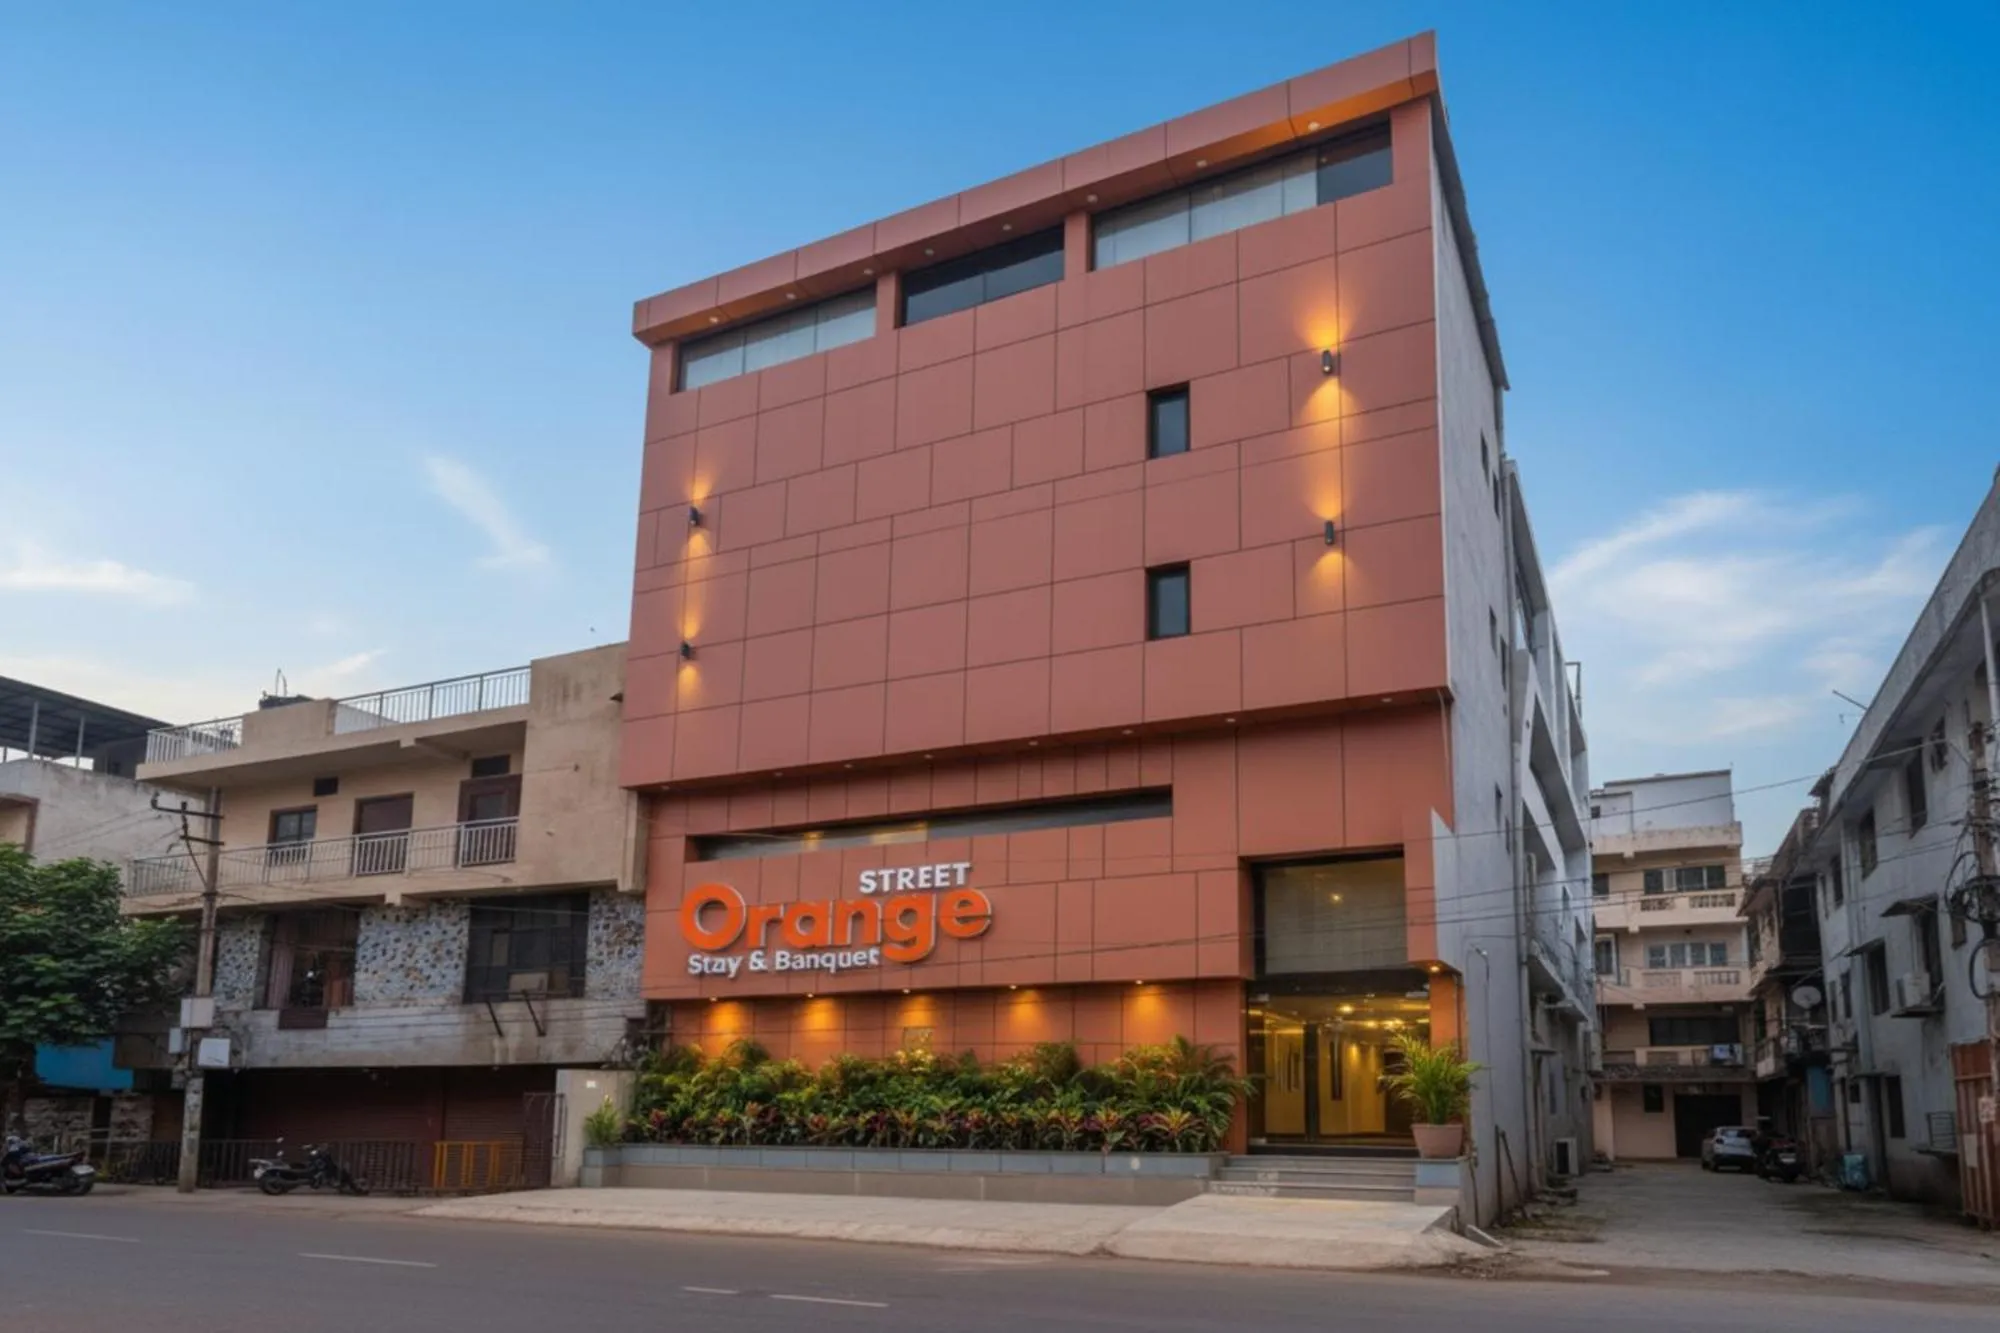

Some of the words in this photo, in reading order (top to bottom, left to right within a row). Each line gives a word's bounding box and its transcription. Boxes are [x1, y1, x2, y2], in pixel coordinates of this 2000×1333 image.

[858, 861, 972, 893] STREET
[680, 882, 993, 963] Orange
[688, 953, 743, 978] Stay
[749, 949, 768, 970] &
[775, 946, 880, 974] Banquet
